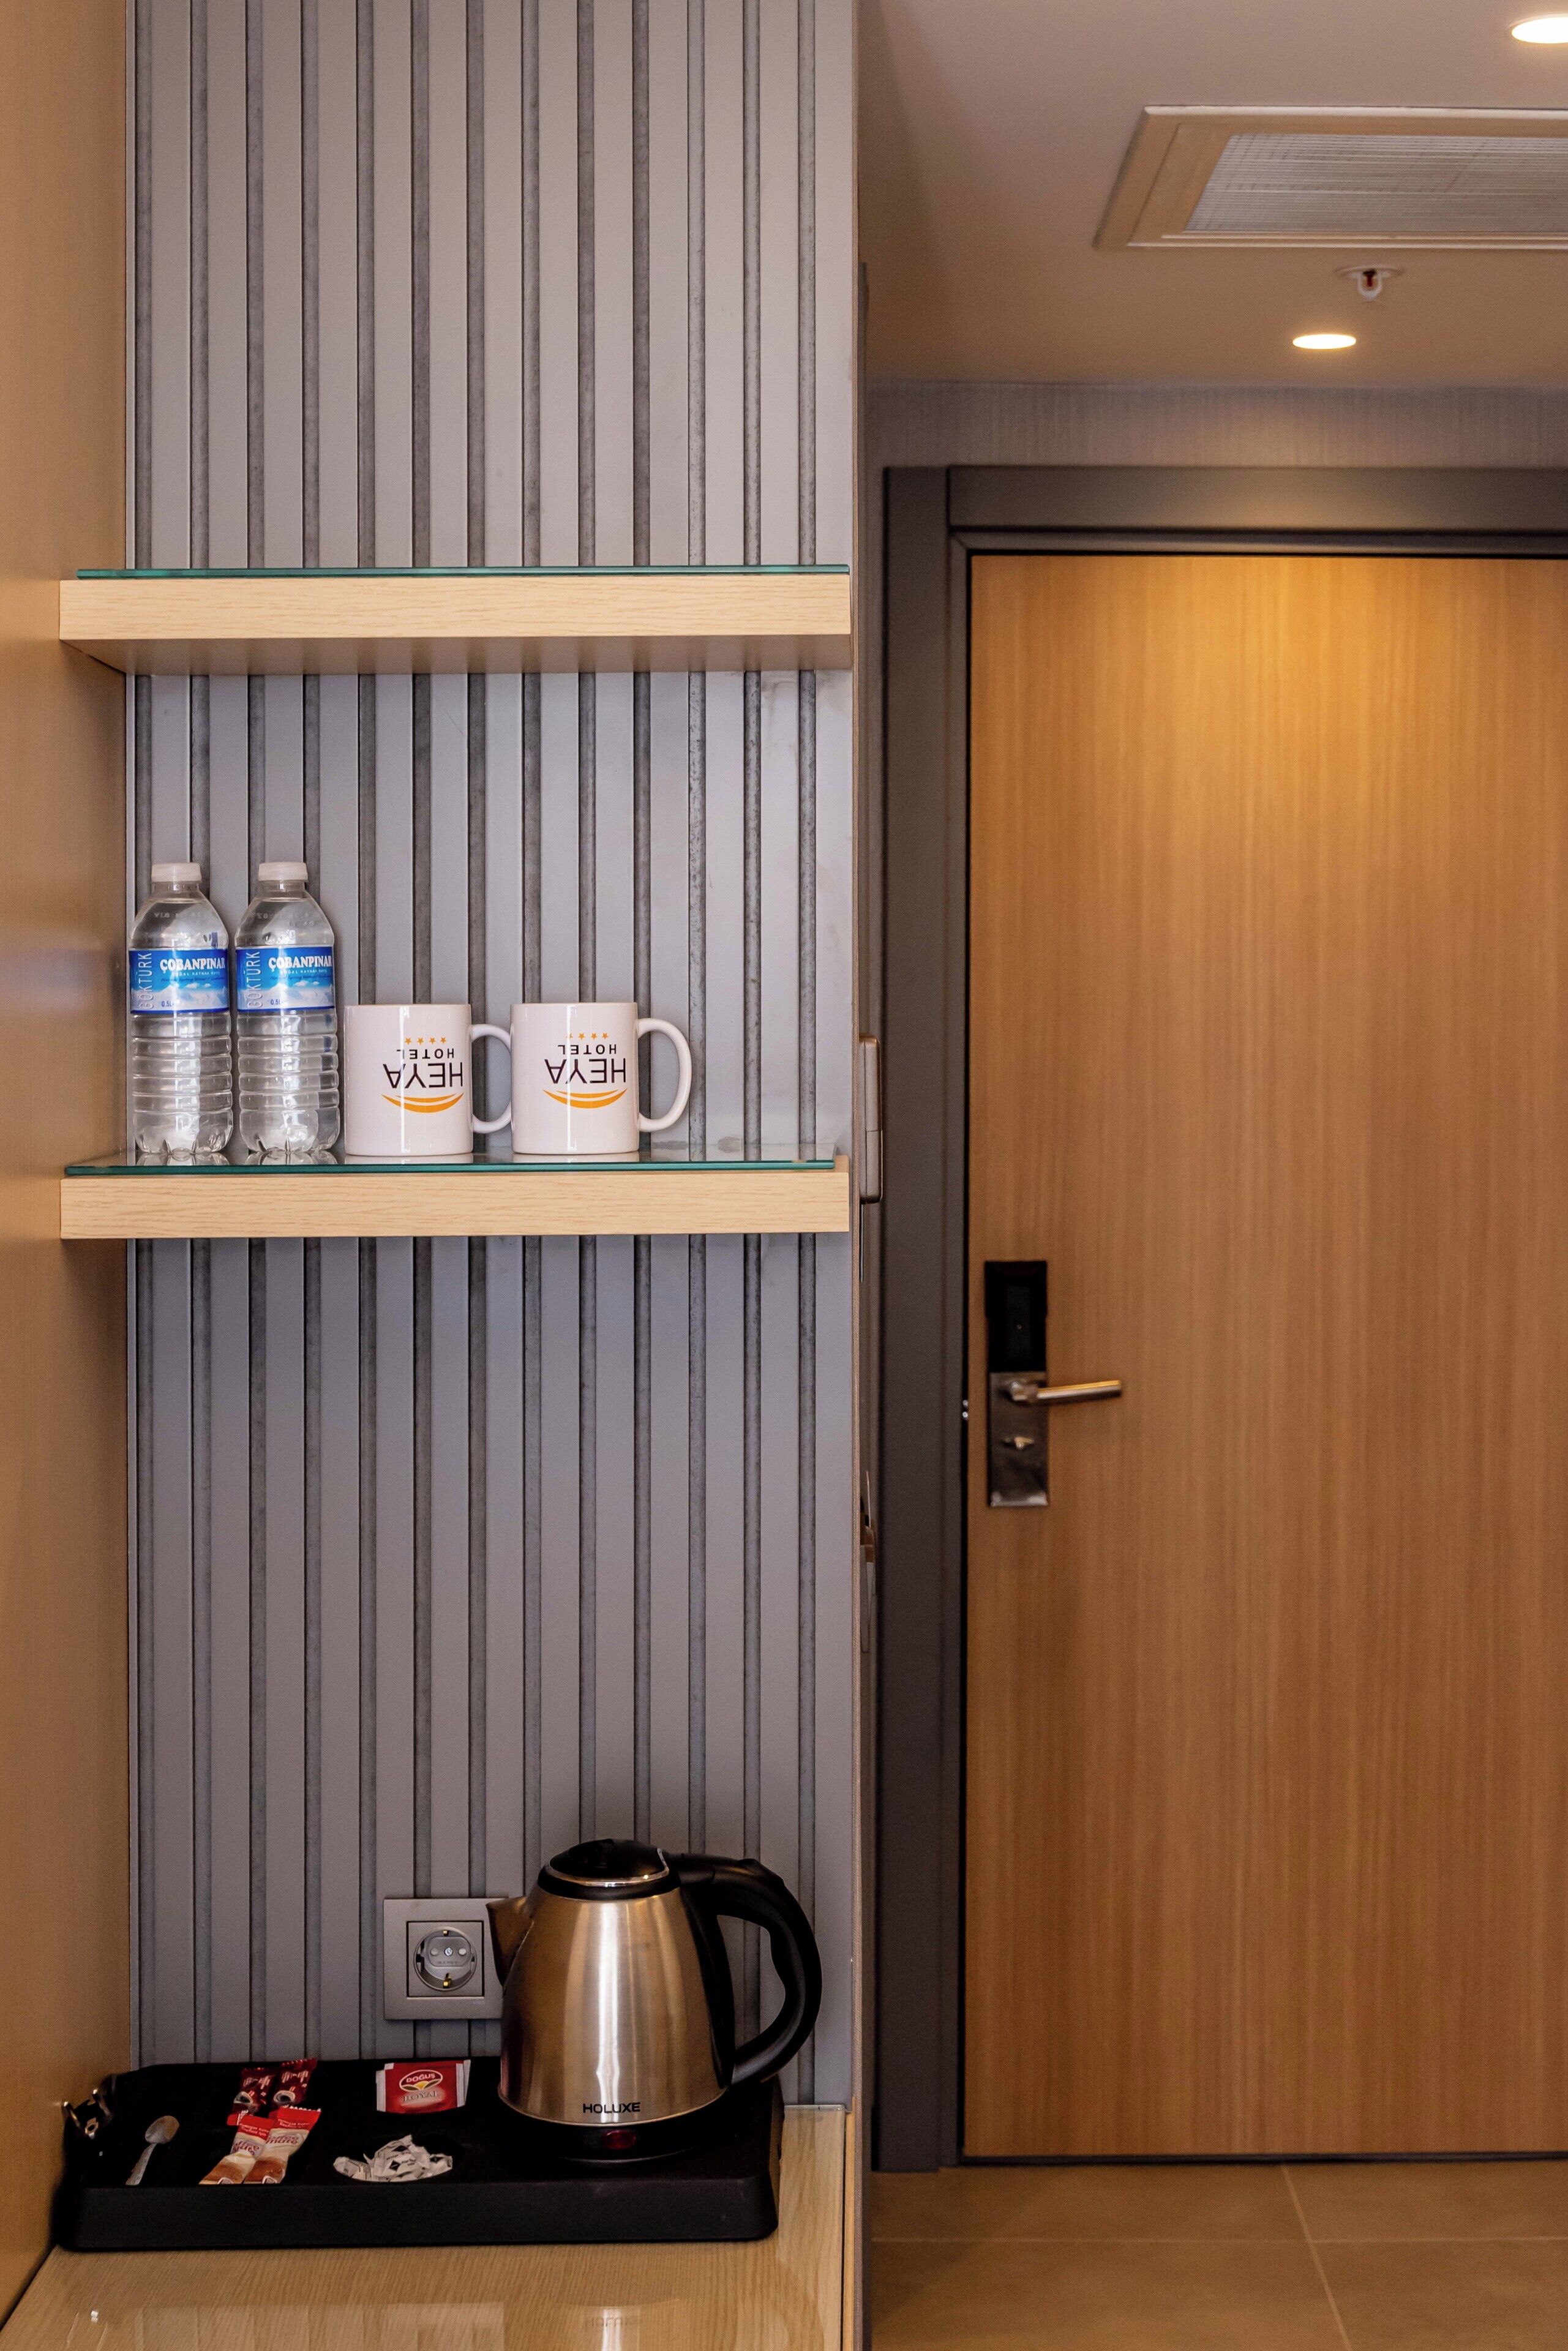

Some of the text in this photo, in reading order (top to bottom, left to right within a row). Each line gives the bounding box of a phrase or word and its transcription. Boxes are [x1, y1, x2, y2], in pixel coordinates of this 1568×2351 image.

[396, 1048, 455, 1060] HOTEL
[557, 1043, 617, 1056] HOTEL
[383, 1062, 463, 1089] HEYA
[544, 1057, 626, 1084] HEYA
[583, 2102, 641, 2113] HOLUXE
